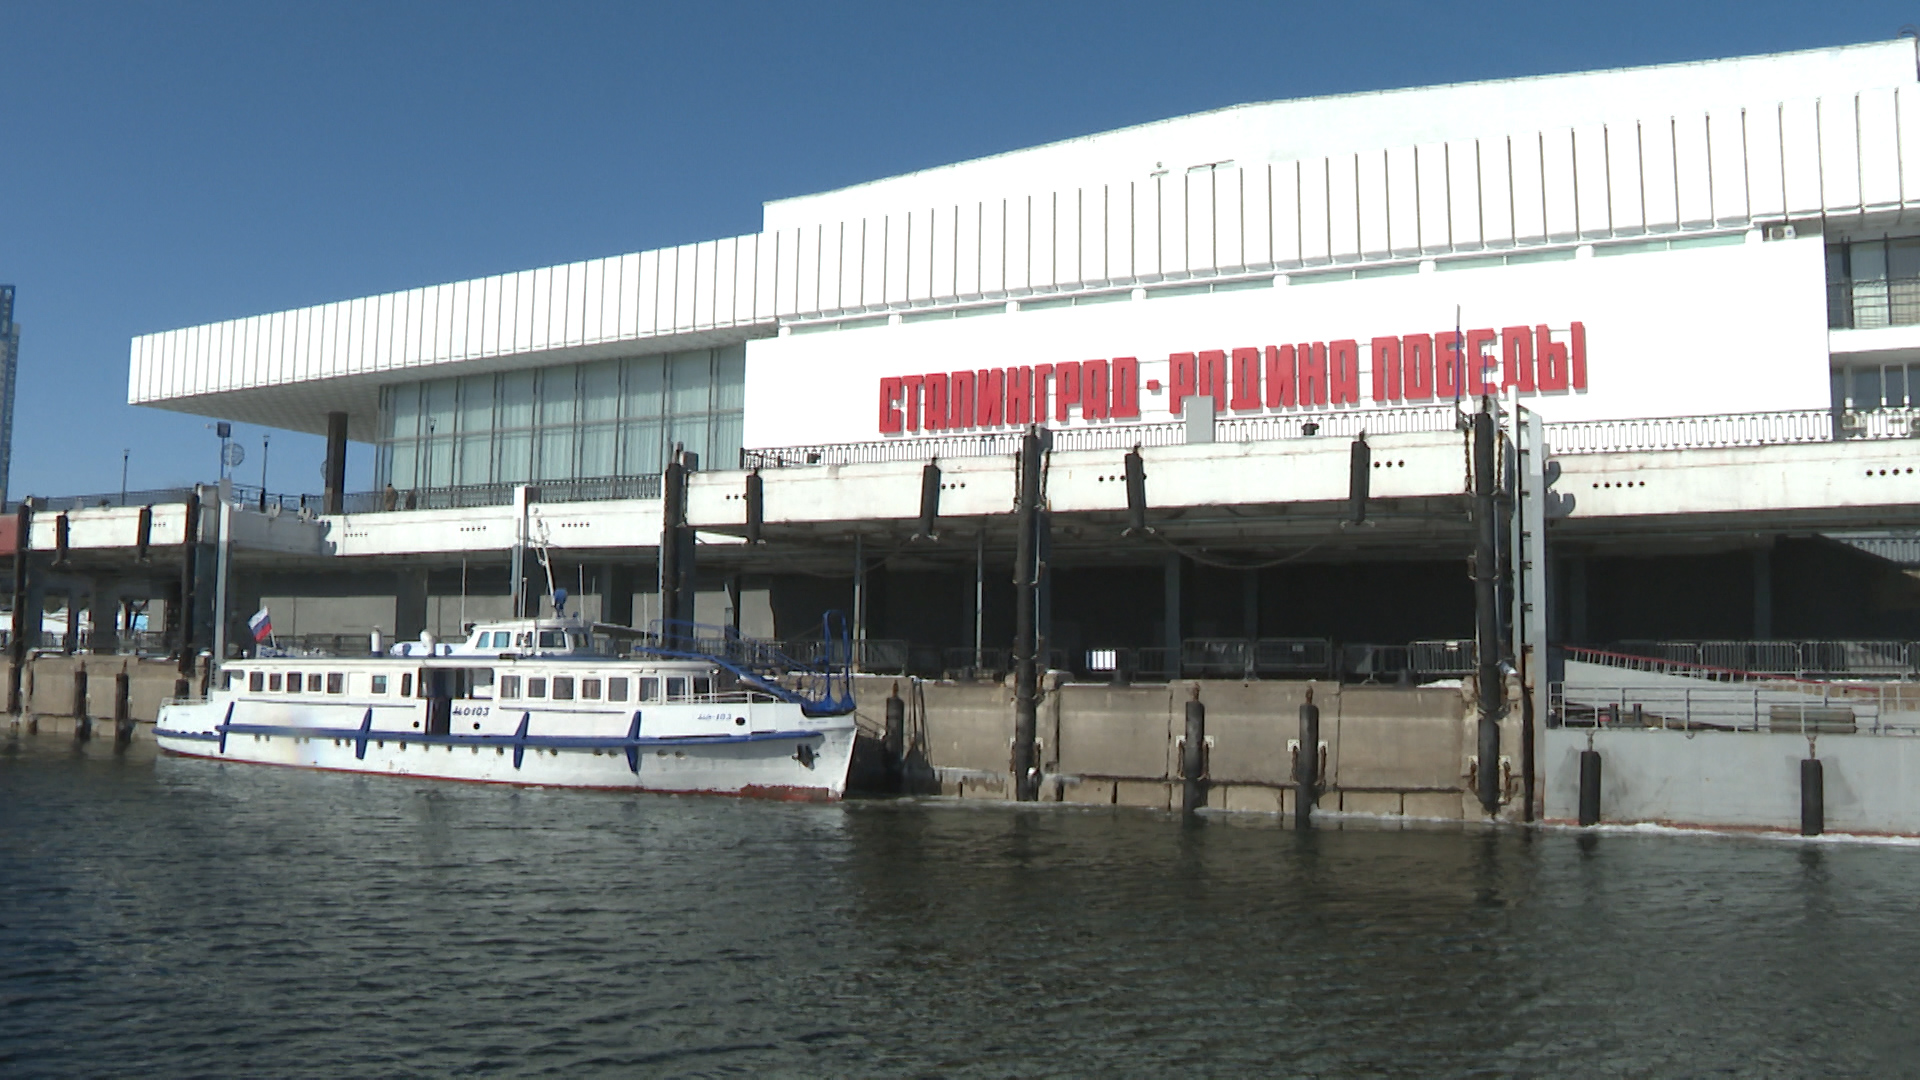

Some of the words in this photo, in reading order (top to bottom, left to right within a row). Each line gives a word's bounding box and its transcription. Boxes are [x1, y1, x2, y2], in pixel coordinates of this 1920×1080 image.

[879, 357, 1140, 434] СТАЛИНГРАД
[1169, 339, 1360, 414] РОДИНА
[1371, 321, 1588, 402] ПОБЕДЫ
